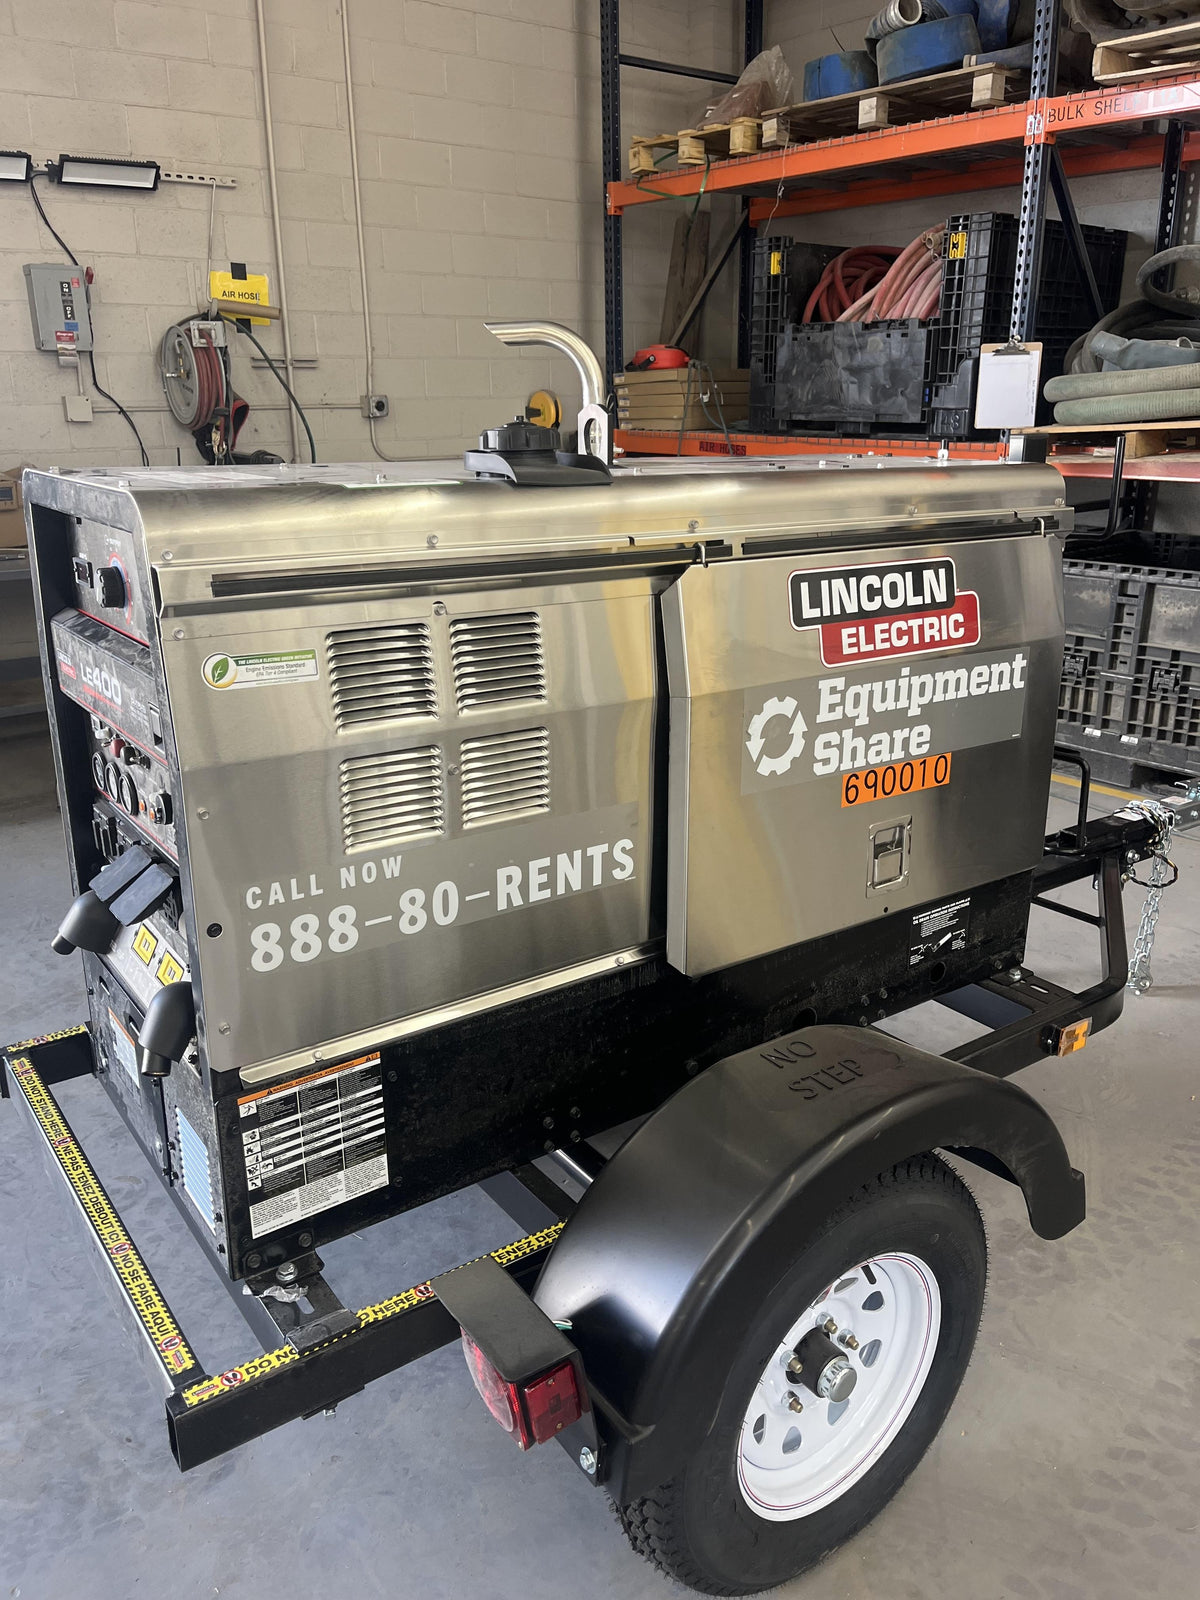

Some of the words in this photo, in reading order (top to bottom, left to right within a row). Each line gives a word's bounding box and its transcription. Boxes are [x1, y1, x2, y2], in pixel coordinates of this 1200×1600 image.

[1048, 103, 1085, 123] BULK
[62, 283, 69, 293] ON
[222, 290, 236, 299] AIR
[800, 568, 948, 619] LINCOLN
[841, 613, 965, 655] ELECTRIC
[815, 653, 1027, 726] Equipment
[813, 724, 932, 776] Share
[844, 755, 949, 805] 690010
[246, 873, 324, 910] CALL
[340, 855, 403, 890] NOW
[249, 838, 635, 973] 888-80-RENTS
[759, 1041, 817, 1069] NO
[24, 1075, 36, 1086] DO
[788, 1059, 864, 1100] STEP
[29, 1085, 43, 1098] NOT
[36, 1098, 54, 1120] STAND
[48, 1119, 65, 1139] HERE
[61, 1145, 74, 1157] NE
[67, 1156, 82, 1172] PAS
[76, 1170, 96, 1197] TENEZ
[89, 1195, 115, 1230] DEBOUT
[107, 1229, 122, 1244] ICI
[120, 1253, 135, 1269] NO
[498, 1242, 534, 1261] ENEZ
[128, 1268, 143, 1284] SE
[135, 1282, 157, 1311] PARE
[372, 1293, 416, 1317] HERE
[245, 1358, 272, 1376] DO
